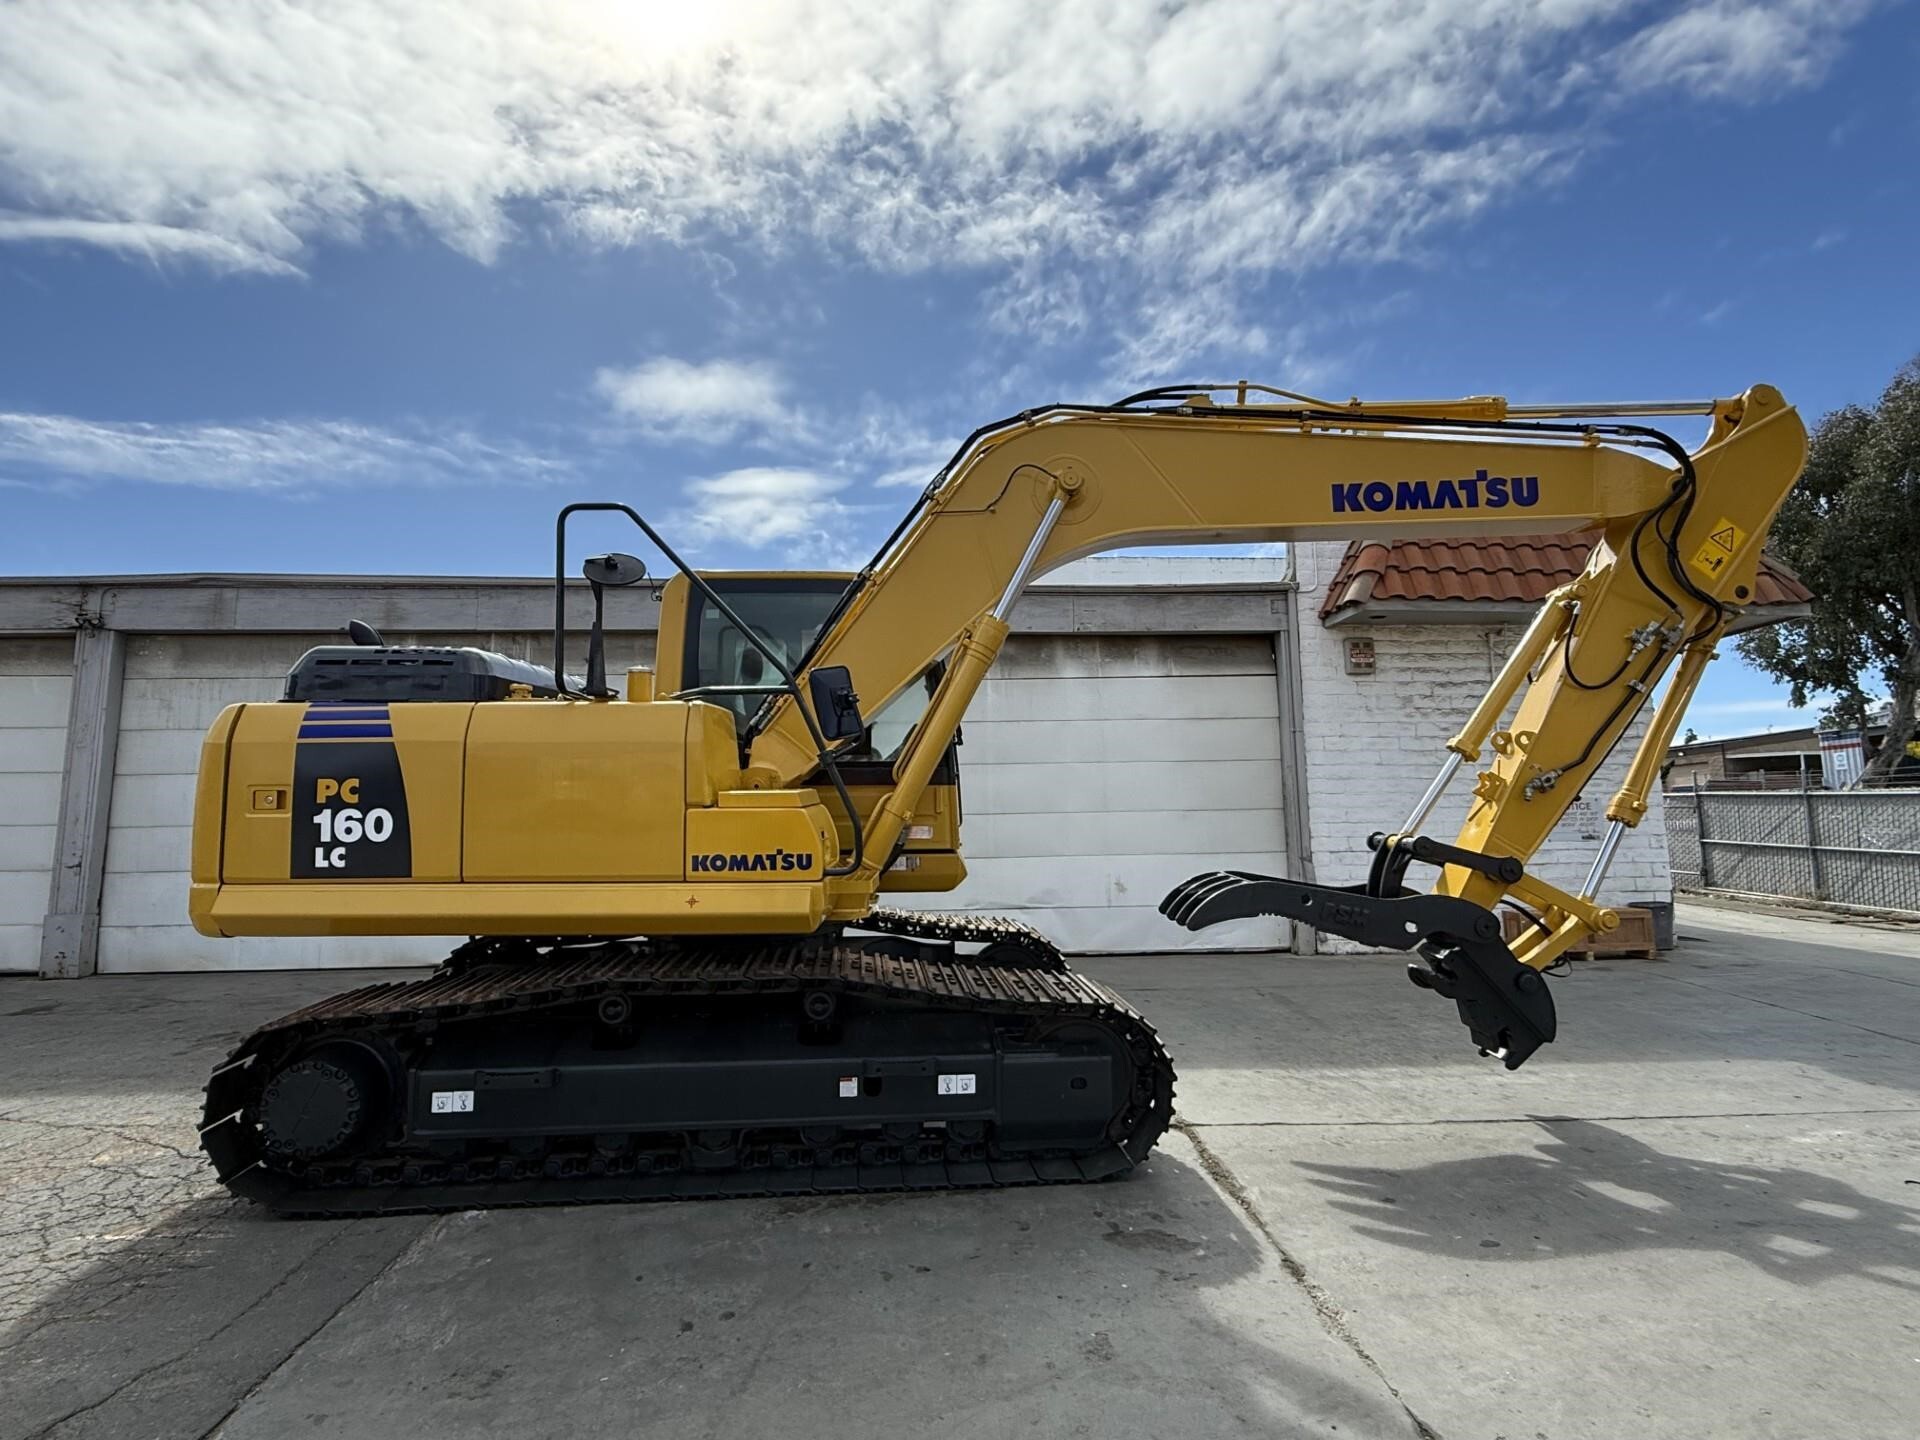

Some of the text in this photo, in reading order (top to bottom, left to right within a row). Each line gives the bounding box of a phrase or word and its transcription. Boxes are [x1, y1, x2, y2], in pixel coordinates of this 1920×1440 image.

[1332, 470, 1539, 512] KOMATSU
[316, 778, 360, 804] PC
[313, 807, 393, 843] 160
[314, 847, 346, 868] LC
[692, 849, 812, 872] KOMATSU
